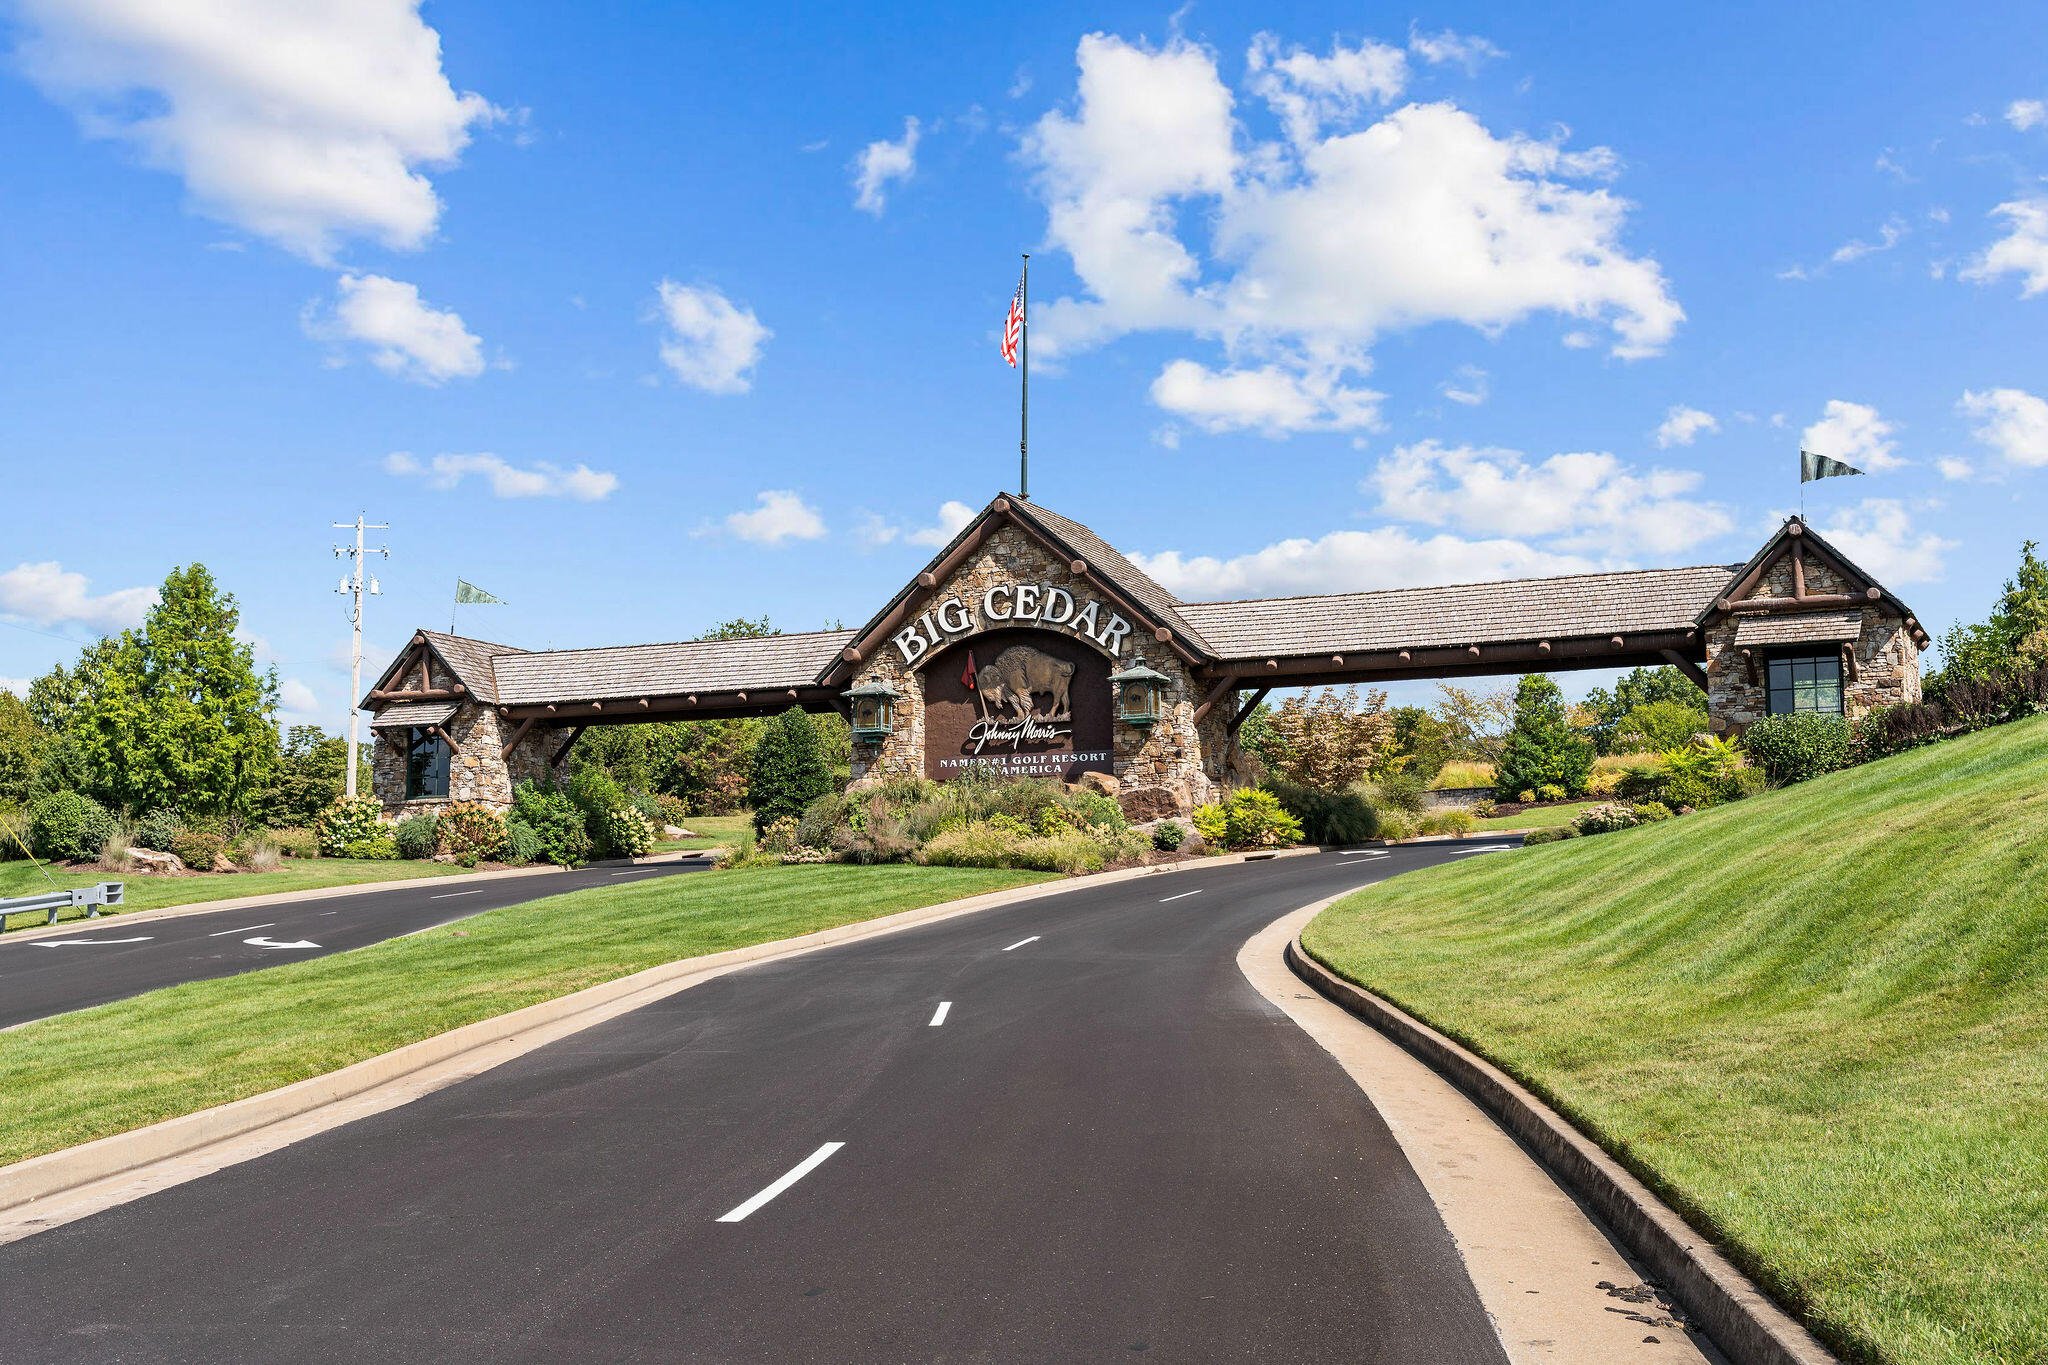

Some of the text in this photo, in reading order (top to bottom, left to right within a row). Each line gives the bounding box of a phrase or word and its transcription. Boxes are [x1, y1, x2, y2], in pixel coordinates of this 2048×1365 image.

[892, 585, 1132, 665] BIG CEDAR
[969, 714, 1072, 754] Johnny Morris
[940, 752, 1107, 768] NAMED #1 GOLF RESORT
[1000, 764, 1063, 775] AMERICA
